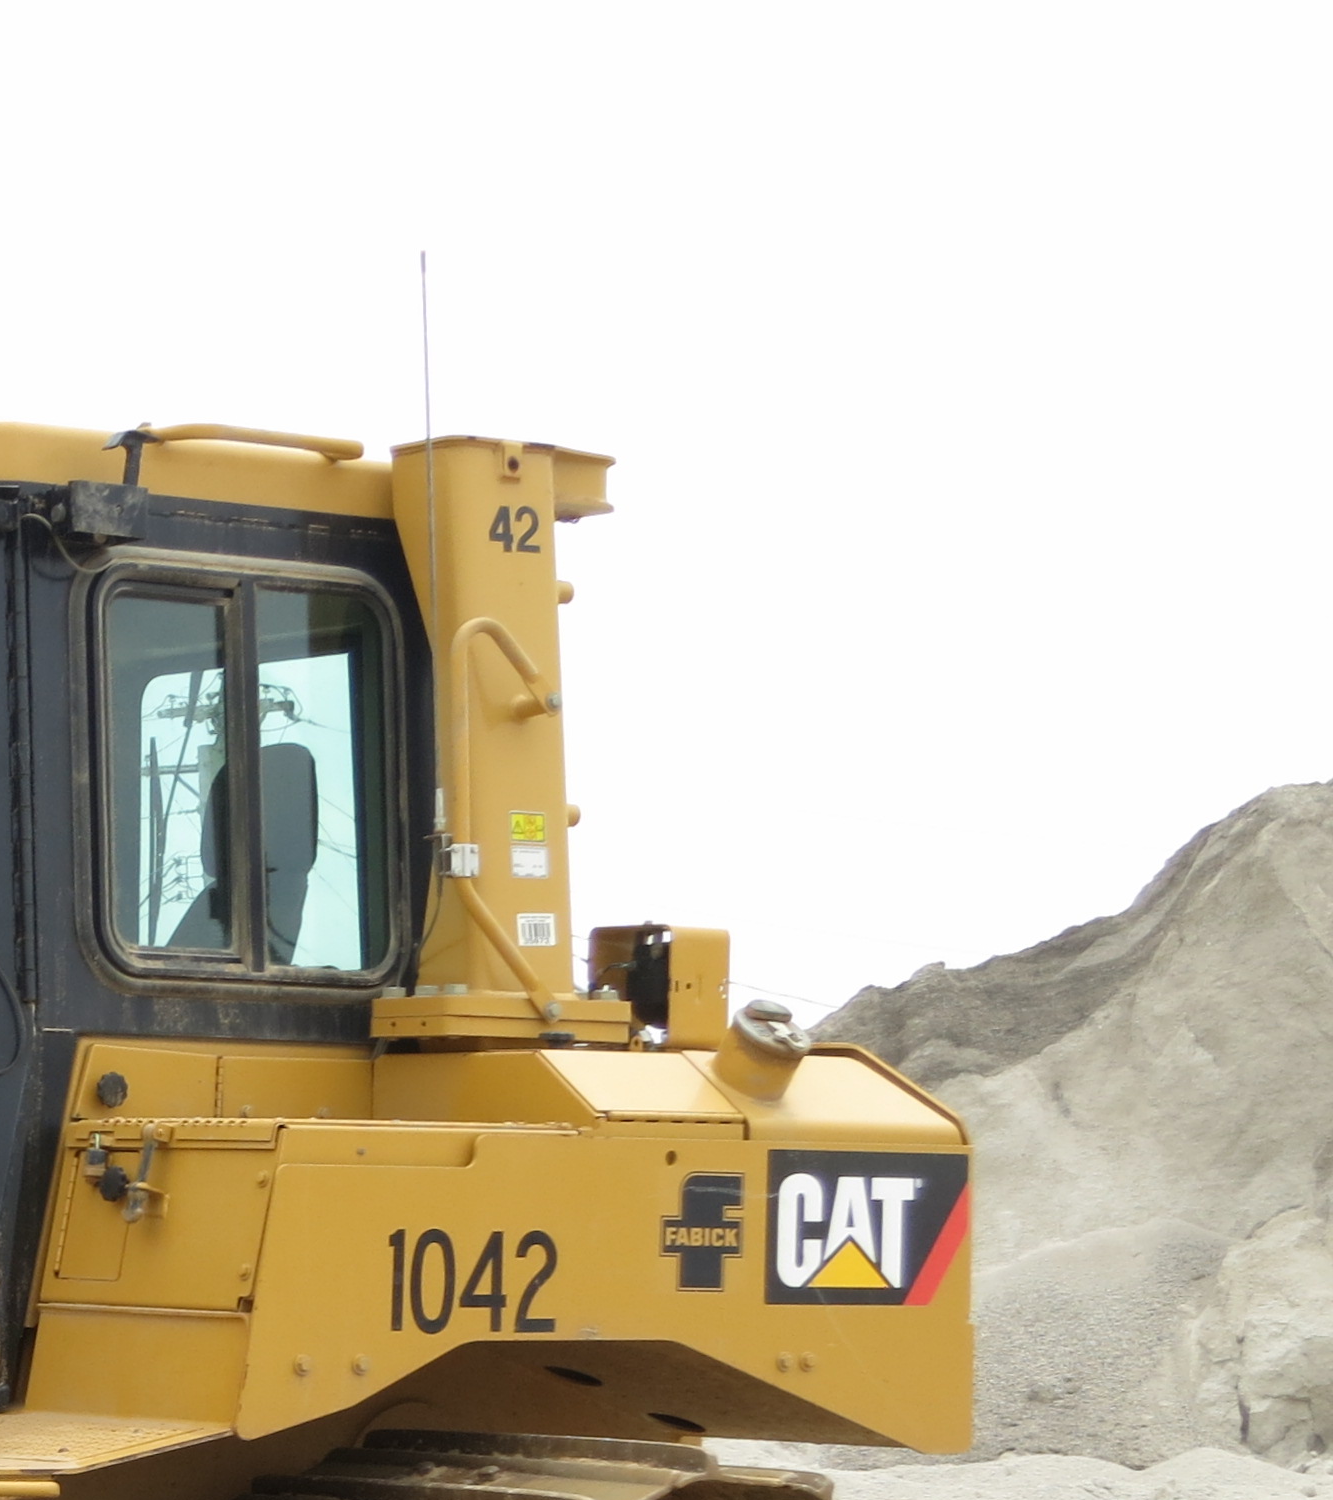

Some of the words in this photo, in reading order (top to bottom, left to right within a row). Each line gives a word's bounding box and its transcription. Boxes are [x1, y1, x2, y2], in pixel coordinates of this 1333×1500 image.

[488, 505, 541, 554] 42
[664, 1226, 738, 1247] FABICK
[777, 1173, 916, 1288] CAT
[389, 1228, 558, 1335] 1042
